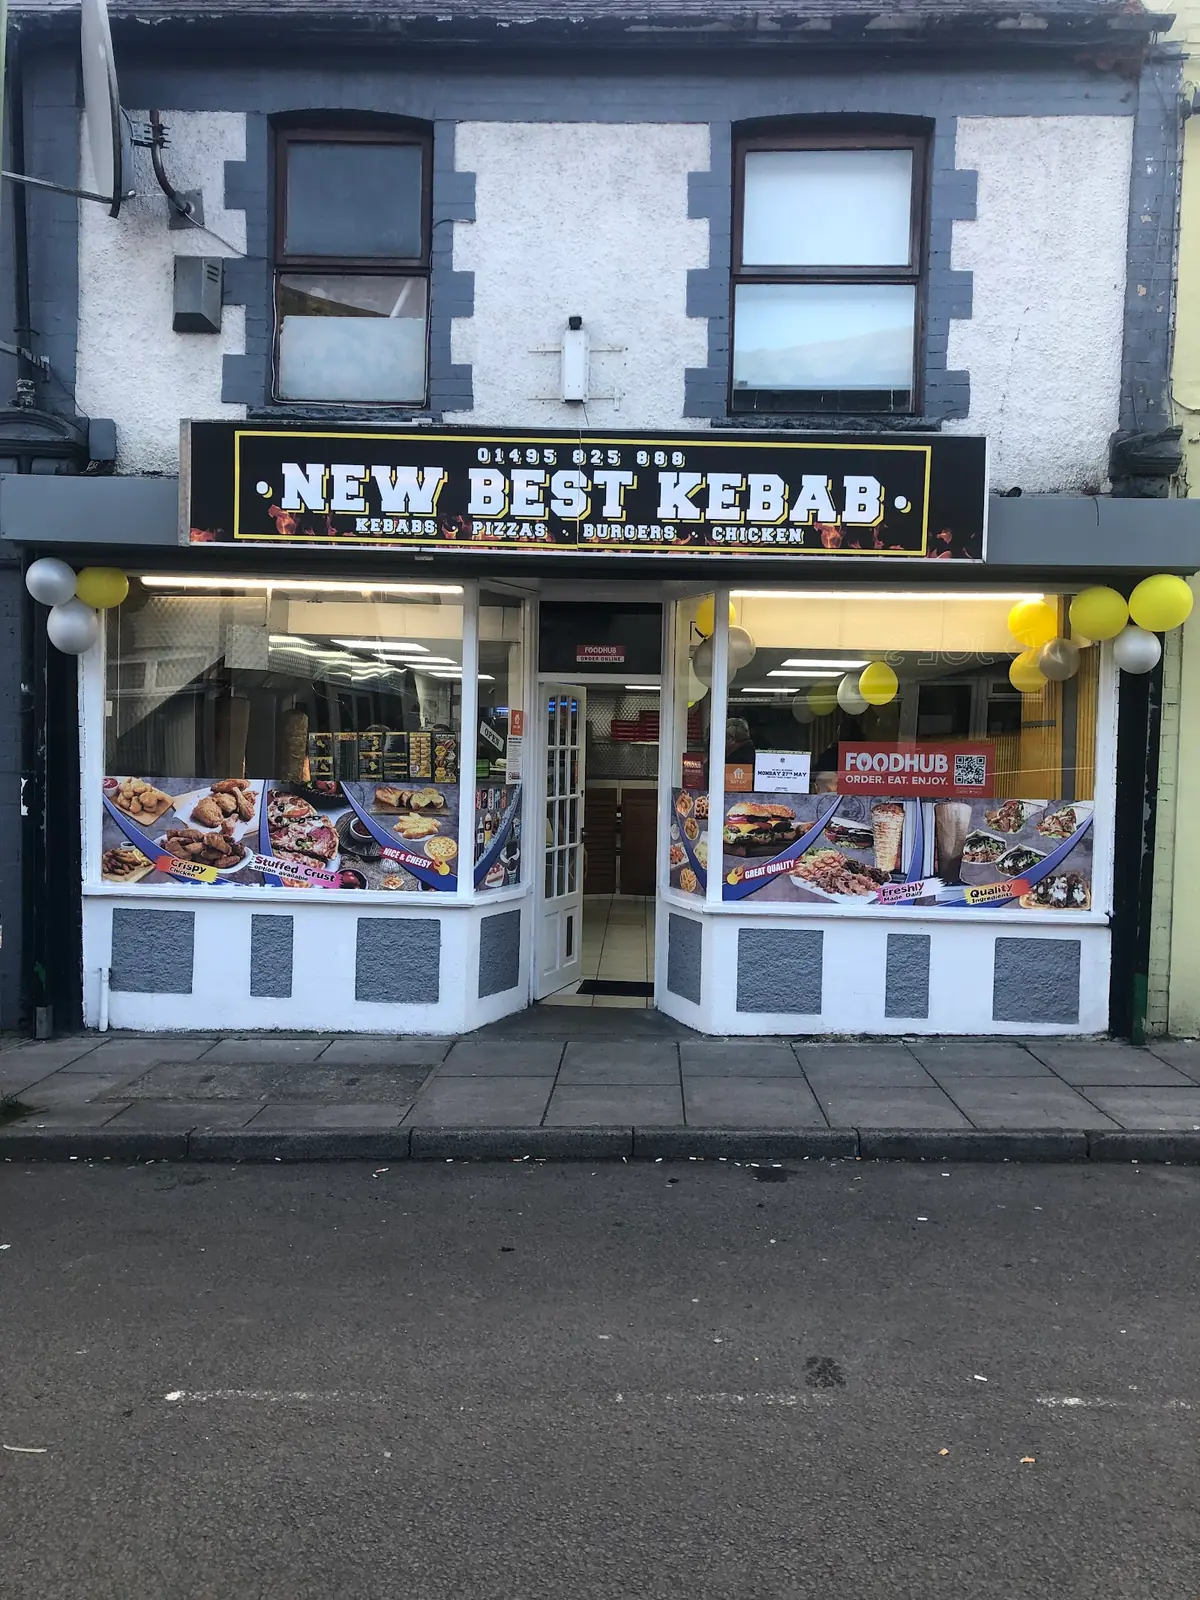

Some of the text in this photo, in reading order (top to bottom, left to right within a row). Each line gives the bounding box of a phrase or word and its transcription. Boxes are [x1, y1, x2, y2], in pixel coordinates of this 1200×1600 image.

[477, 447, 557, 465] 01495
[572, 449, 621, 467] 825
[281, 463, 885, 527] NEW BEST KEBAB
[355, 517, 804, 545] KEBABS PIZZAS BURGERS CHICKEN
[584, 646, 617, 654] FOODHUB
[484, 727, 501, 747] OPEN
[845, 752, 949, 774] FOODHUB
[845, 775, 949, 786] ORDER. EAT. ENJOY.
[170, 858, 207, 875] Crispy
[383, 847, 432, 869] NICE & CHEESY
[169, 866, 196, 878] Chicken
[254, 856, 336, 883] Stuffed Crust
[254, 865, 309, 882] option available
[744, 859, 795, 879] GREAT QUALITY
[882, 882, 925, 898] Freshly
[883, 890, 923, 903] Made Daily
[970, 883, 1013, 899] Quality
[971, 892, 1013, 904] Ingredients
